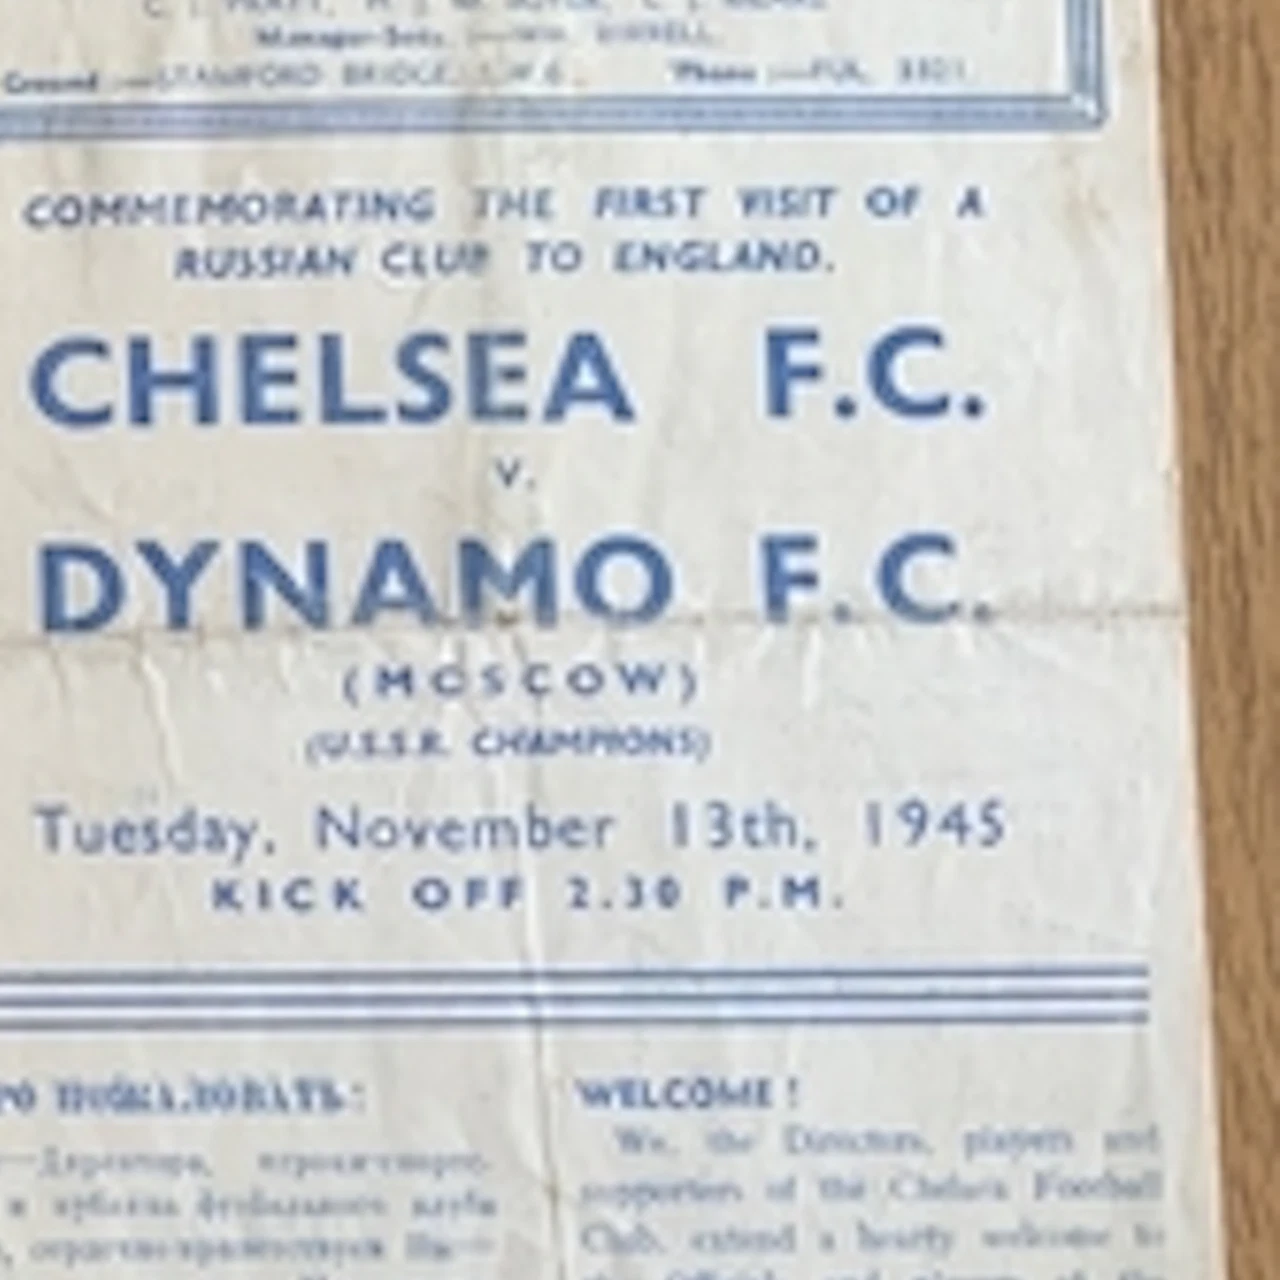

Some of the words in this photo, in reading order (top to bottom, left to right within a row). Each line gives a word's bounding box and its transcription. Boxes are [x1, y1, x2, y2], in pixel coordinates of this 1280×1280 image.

[22, 188, 434, 230] COMMEMORATING
[473, 188, 553, 221] THE
[594, 186, 706, 218] FIRST
[739, 186, 837, 218] VISIT
[865, 186, 920, 218] OF
[958, 187, 982, 217] A
[175, 246, 357, 279] RUSSIAN
[380, 241, 490, 278] CLUB
[526, 240, 583, 273] TO
[614, 240, 833, 273] ENGLAND.
[30, 330, 635, 429] CHELSEA
[766, 326, 984, 419] F.C.
[39, 534, 673, 634] DYNAMO
[760, 532, 994, 625] F.C.
[343, 658, 696, 706] (MOSCOW)
[470, 726, 710, 761] CHAMPIONS)
[33, 804, 275, 862] Tuesday,
[315, 800, 614, 853] November
[673, 800, 817, 853] 13th,
[867, 798, 1004, 848] 1945
[212, 877, 363, 913] KICK
[412, 875, 523, 912] OFF
[568, 875, 680, 909] 2.30
[725, 875, 841, 908] P.M.
[963, 1126, 1074, 1162] players
